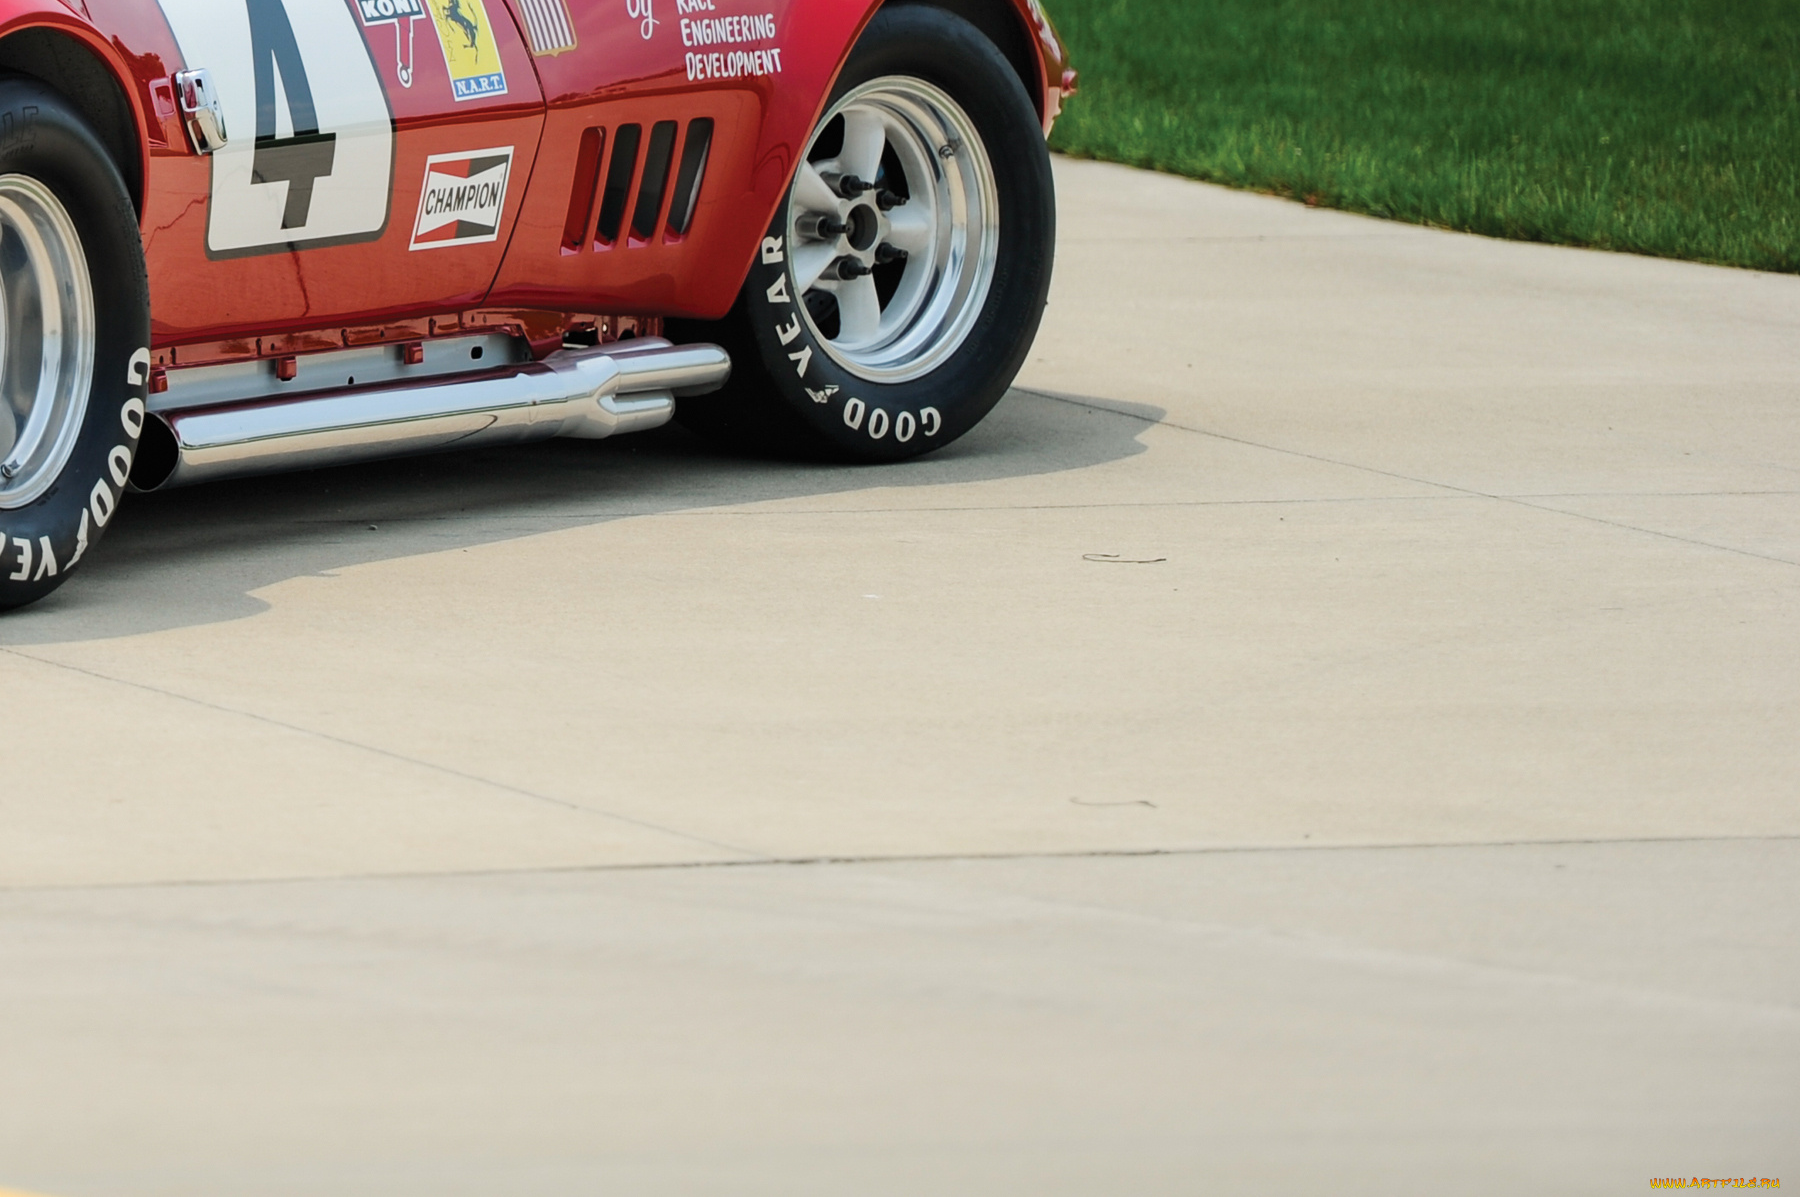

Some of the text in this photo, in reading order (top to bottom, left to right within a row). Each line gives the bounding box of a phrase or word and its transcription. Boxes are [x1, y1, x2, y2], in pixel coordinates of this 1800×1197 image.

[680, 13, 776, 47] ENGINEERING
[685, 48, 782, 81] DEVELOPMENT
[456, 75, 503, 95] N.A.R.T.
[425, 181, 500, 215] CHAMPION
